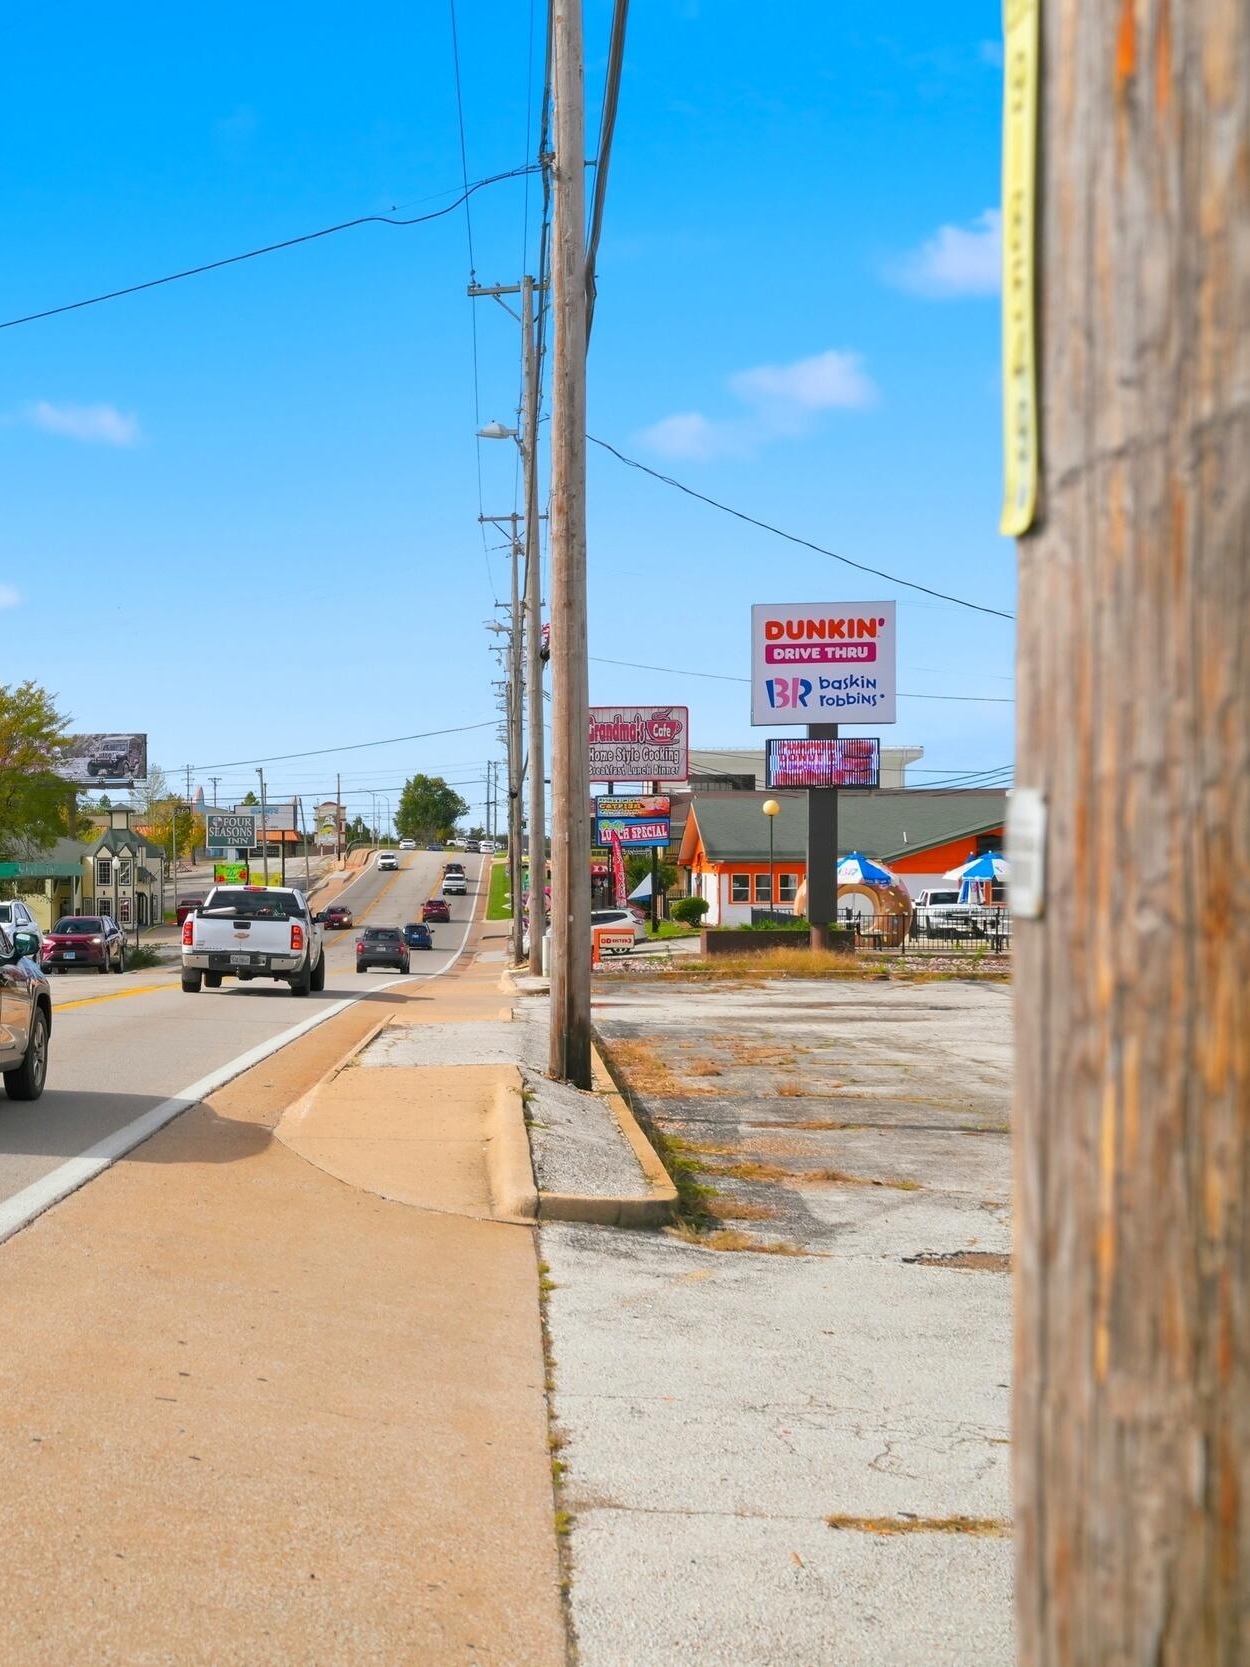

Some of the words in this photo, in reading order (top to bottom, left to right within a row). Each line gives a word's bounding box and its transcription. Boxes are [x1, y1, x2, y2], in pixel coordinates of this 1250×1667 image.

[765, 618, 885, 640] DUNKIN'
[773, 648, 821, 660] DRIVE
[825, 647, 868, 658] THRU
[766, 677, 812, 708] BR
[653, 723, 671, 737] Cafe
[616, 747, 640, 764] Style
[642, 747, 680, 764] Cooking
[654, 764, 679, 775] Dinner
[223, 817, 251, 827] FOUR
[209, 827, 252, 837] SEASONS
[631, 825, 668, 839] SPECIAL
[227, 837, 248, 845] INN
